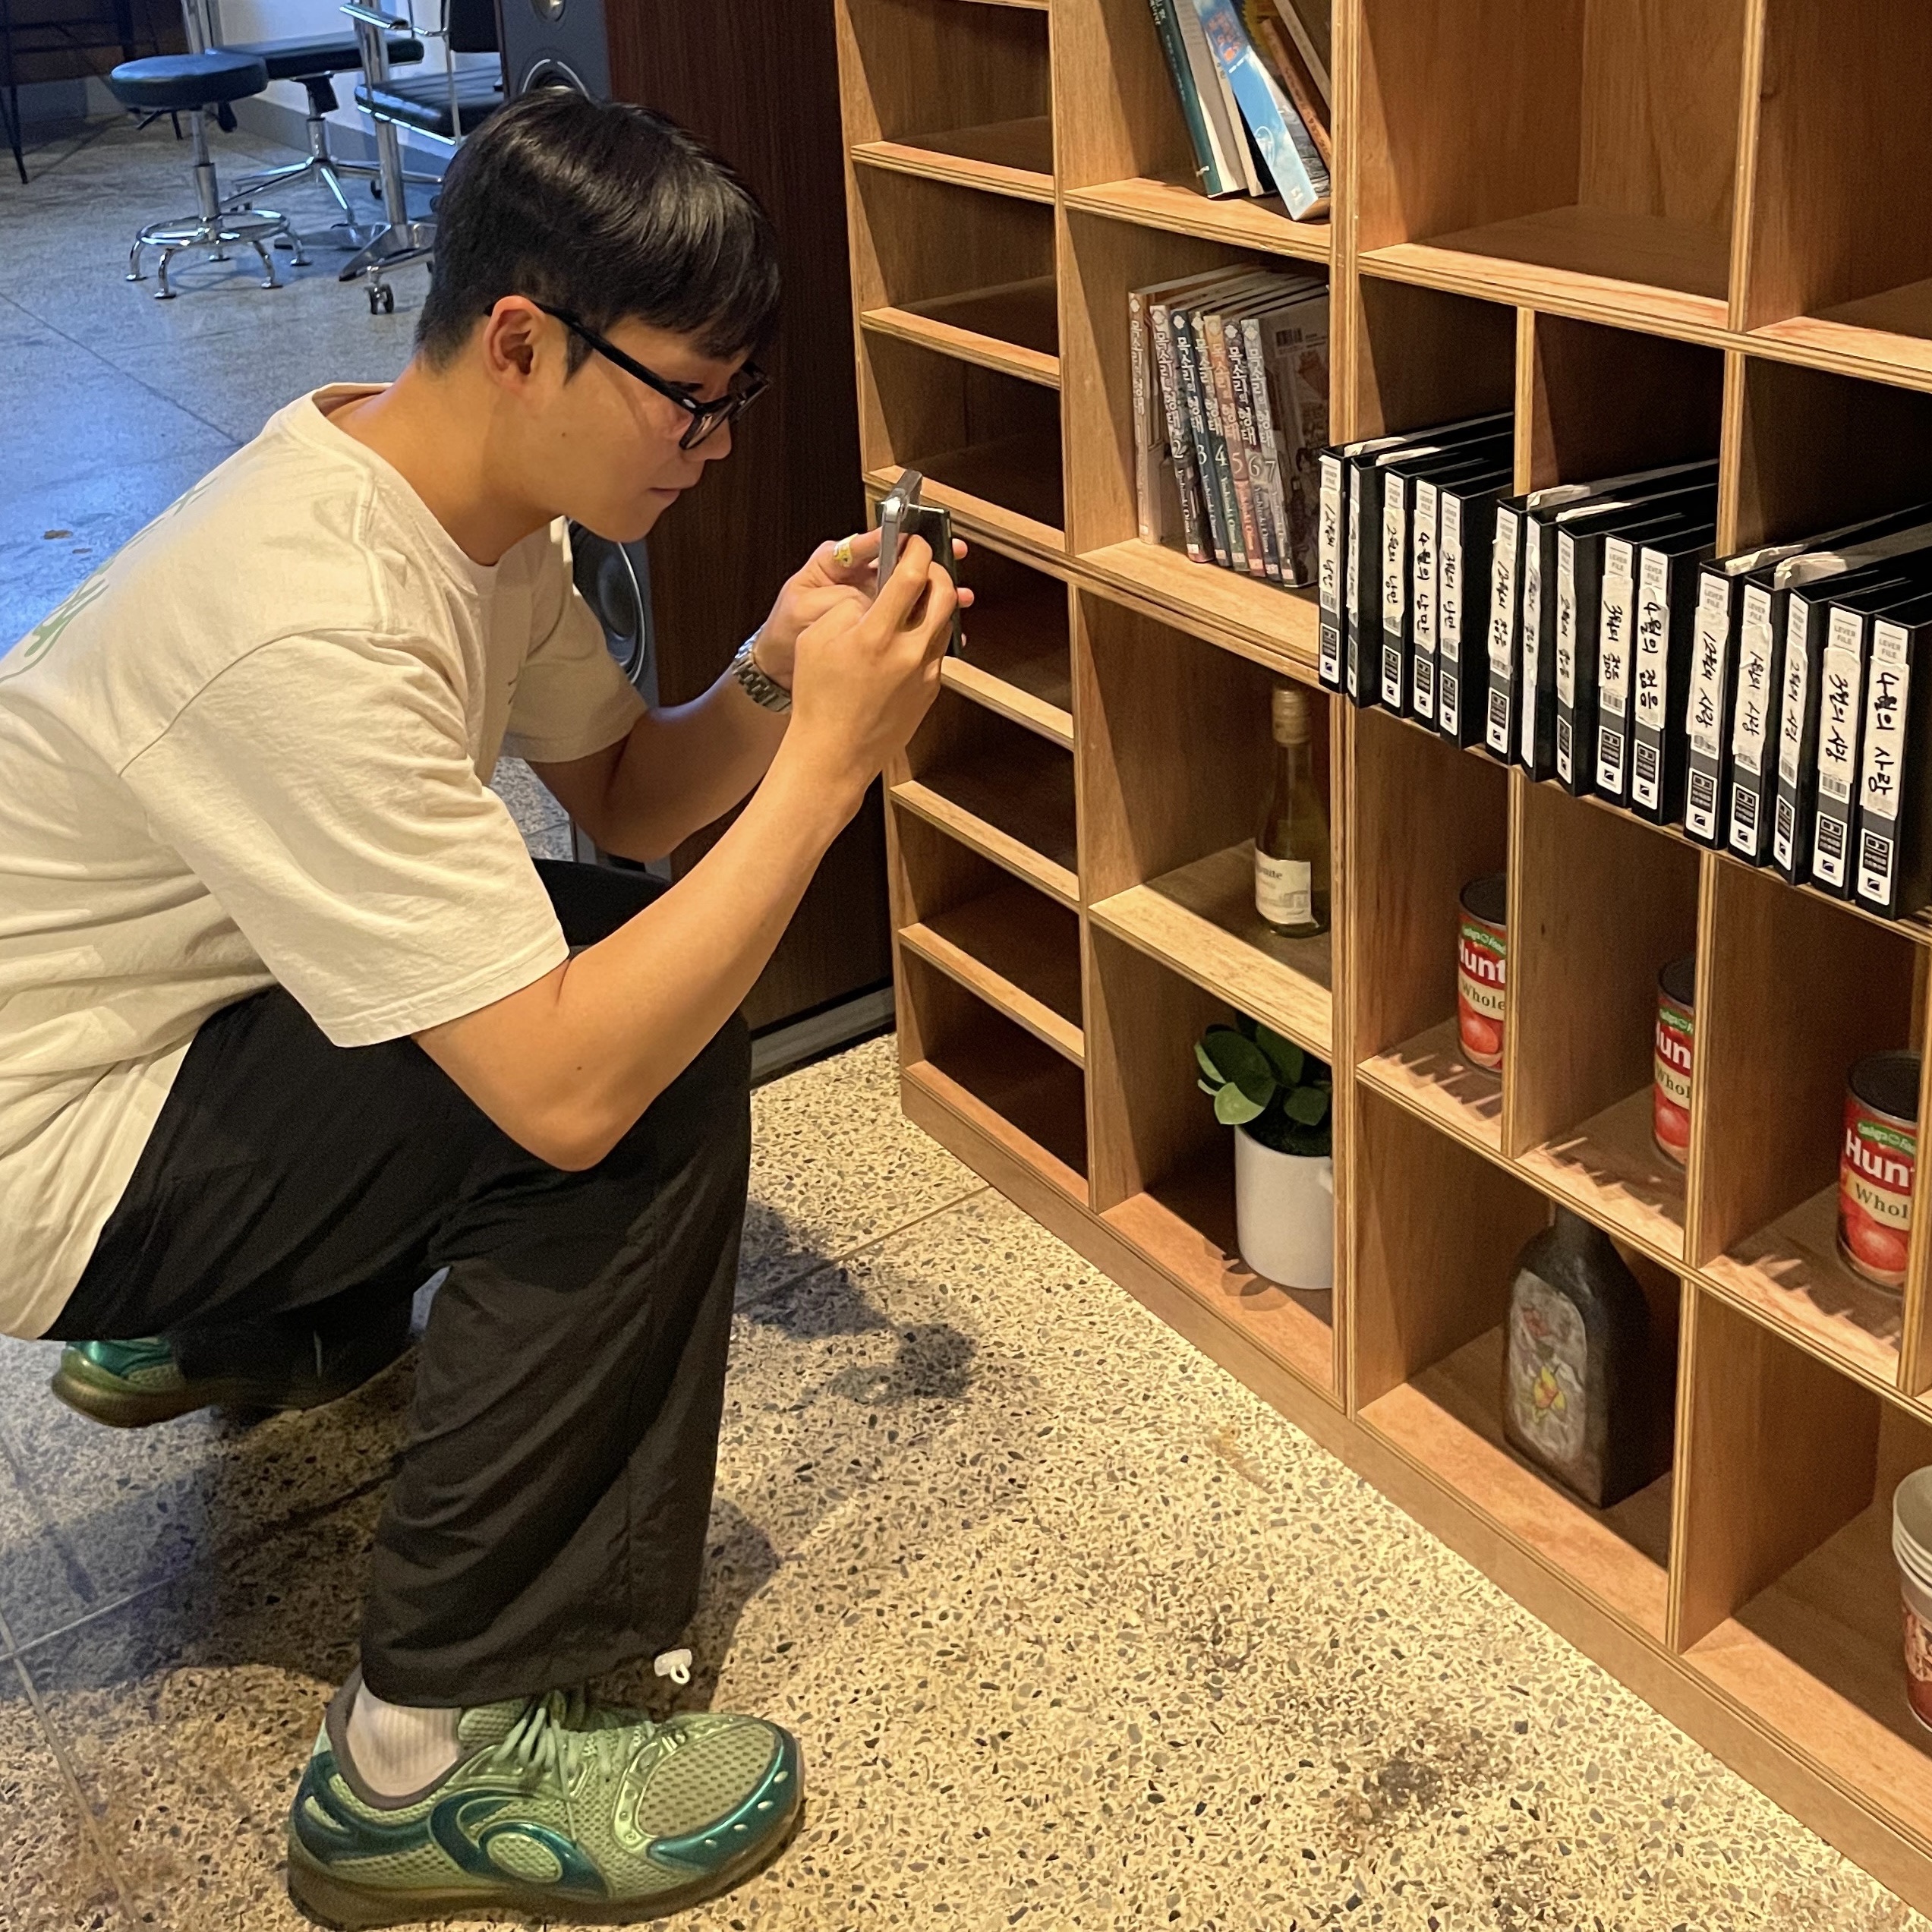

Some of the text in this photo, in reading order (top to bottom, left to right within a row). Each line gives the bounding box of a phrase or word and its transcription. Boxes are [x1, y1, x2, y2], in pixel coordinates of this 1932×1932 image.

[1177, 336, 1207, 465] 목소리의 형태 3
[1195, 339, 1228, 466] 목소리의 형태 4
[1212, 343, 1243, 474] 목소리의 형태 5
[1228, 346, 1260, 477] 목소리의 형태 6
[1247, 348, 1276, 483] 목소리의 형태 7
[1172, 440, 1183, 459] 2
[1385, 575, 1398, 604] 낭만
[1417, 532, 1432, 634] 4월의 낭만
[1443, 600, 1455, 629] 낭만
[1603, 601, 1622, 679] 3월의 젊음
[1640, 602, 1661, 709] 4월의 젊음
[1834, 626, 1856, 637] LEVER
[1837, 635, 1852, 645] FILE
[1879, 638, 1901, 651] LEVER
[1882, 648, 1896, 659] FILE
[1695, 631, 1717, 728] 12월의 사랑
[1742, 651, 1764, 736] 1월의 사랑
[1785, 659, 1801, 742] 2월의 사랑
[1826, 674, 1849, 762] 3월의 사랑
[1869, 673, 1899, 795] 4월의 사랑
[1462, 979, 1505, 1011] Whole
[1846, 1128, 1915, 1187] Hun
[1856, 1183, 1908, 1218] Whol
